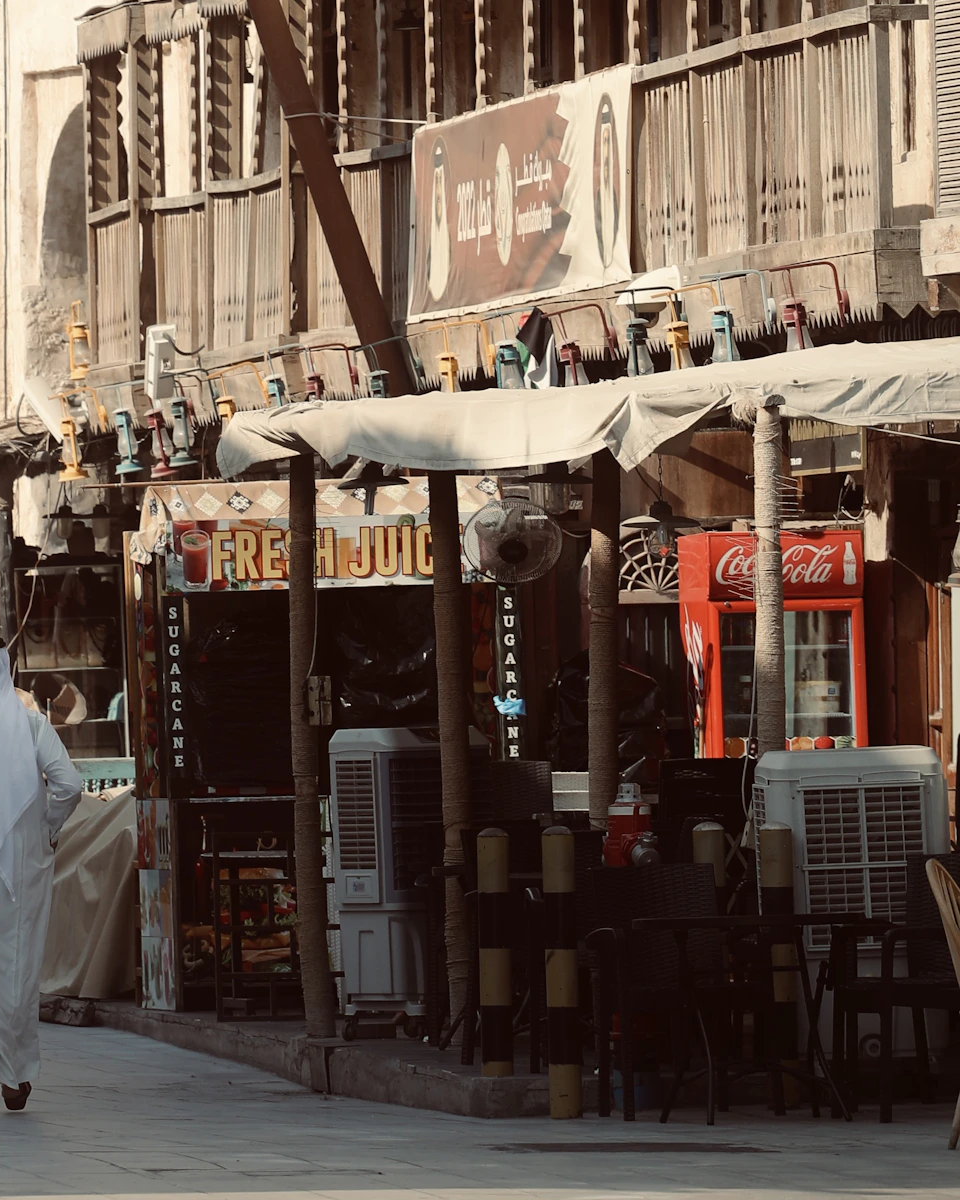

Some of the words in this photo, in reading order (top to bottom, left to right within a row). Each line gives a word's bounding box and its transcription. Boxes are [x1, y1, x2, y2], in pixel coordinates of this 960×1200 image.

[456, 180, 476, 242] 2022
[477, 178, 492, 257] قطر
[211, 524, 336, 582] FREH
[346, 523, 464, 578] JUIC
[167, 606, 185, 768] SUGARCANE
